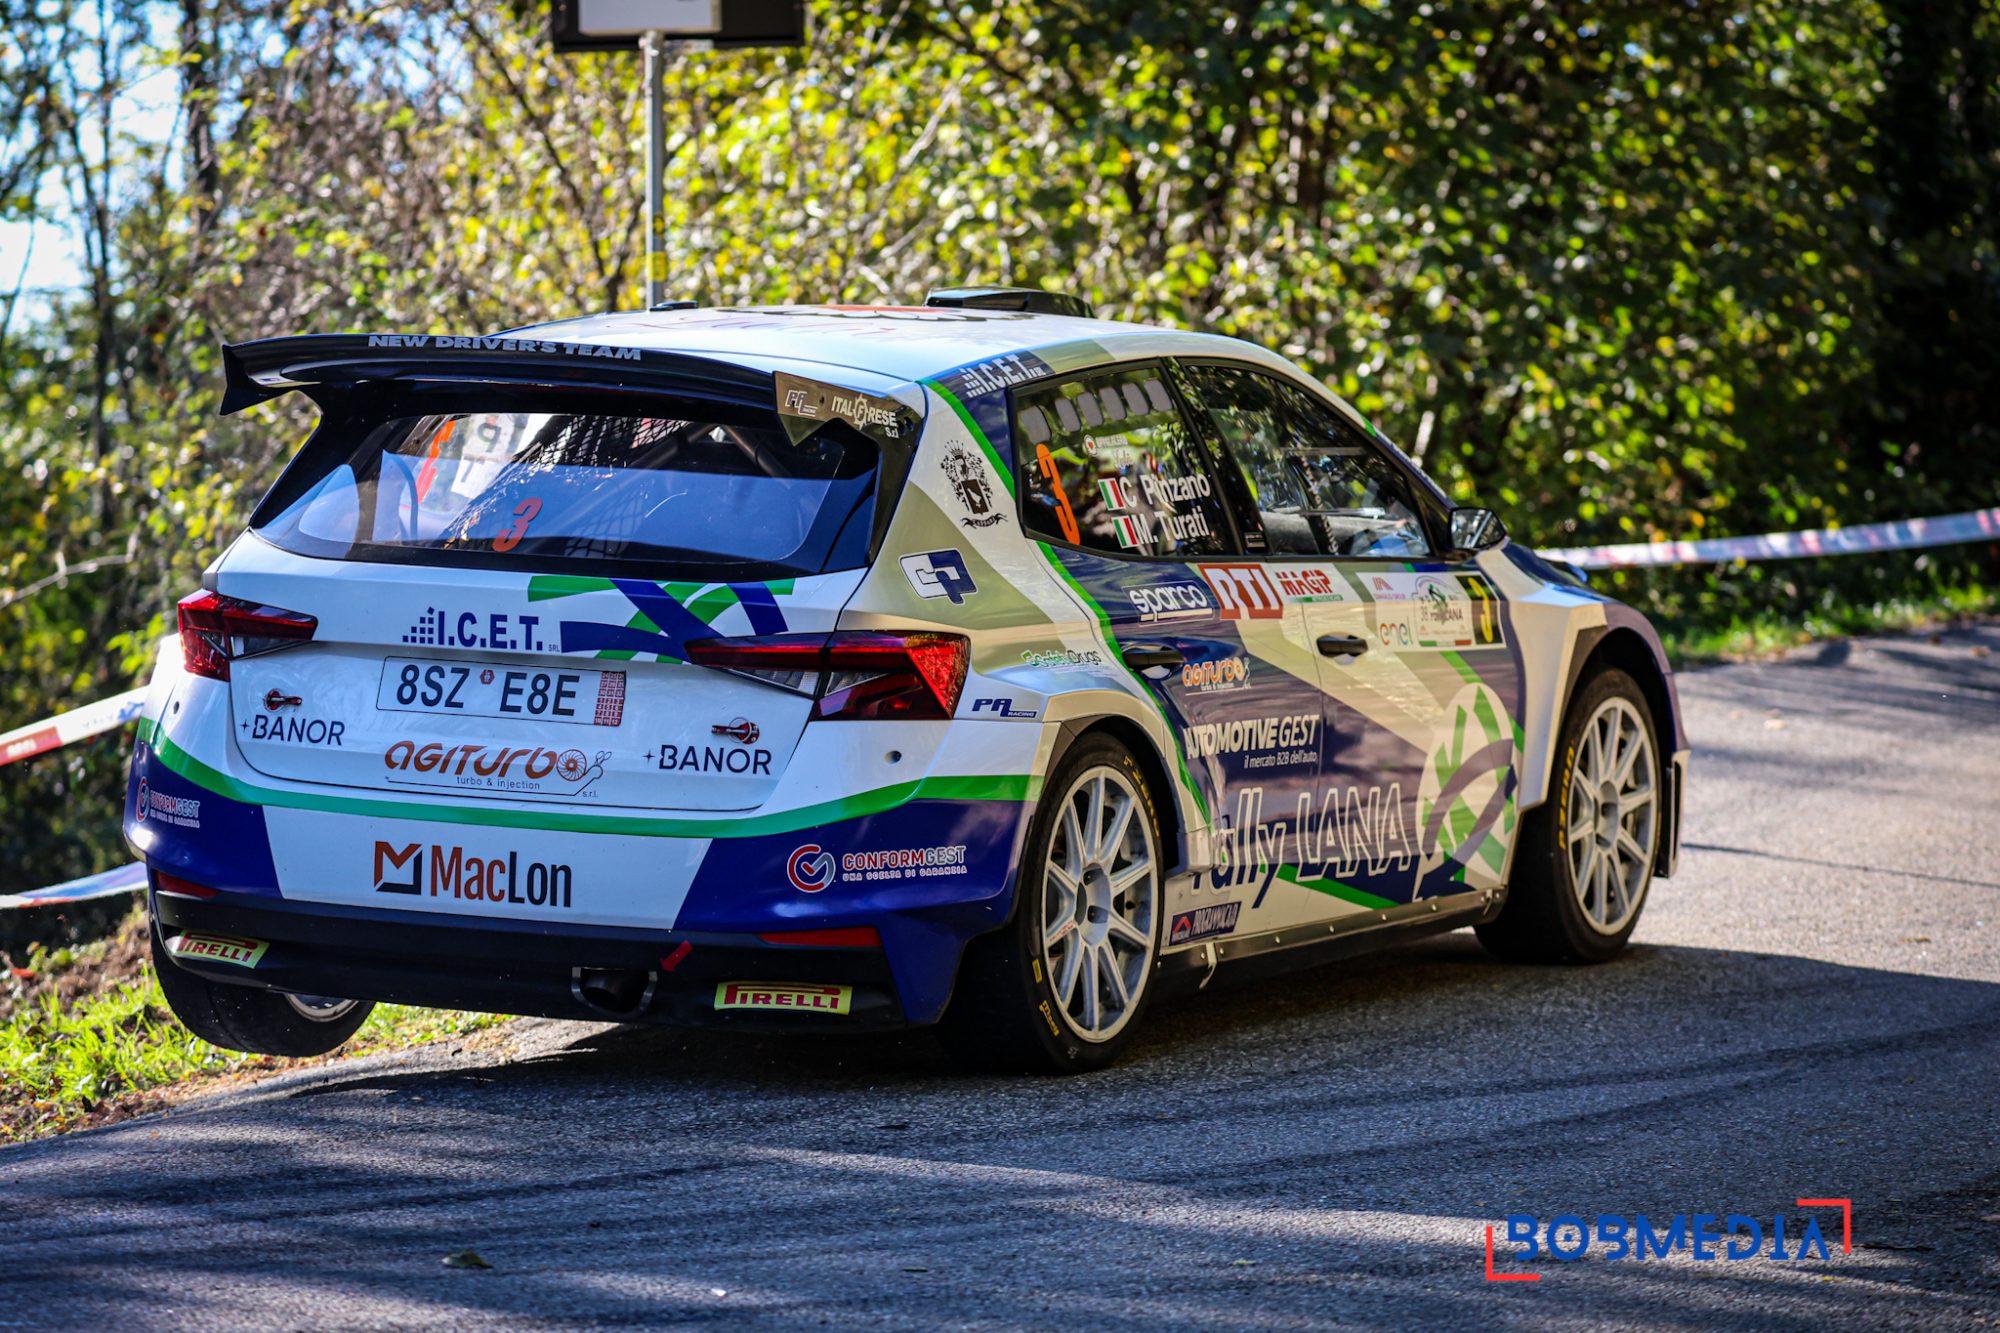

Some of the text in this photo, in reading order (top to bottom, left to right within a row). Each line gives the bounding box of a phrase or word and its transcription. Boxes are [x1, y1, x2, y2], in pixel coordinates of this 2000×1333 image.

[367, 335, 642, 361] NEW DRIVER'S TEAM
[1036, 442, 1081, 546] 3
[1140, 473, 1211, 505] Pinzano
[492, 497, 544, 553] 3
[1131, 506, 1210, 545] M. Turati
[1129, 584, 1208, 622] sparco
[1467, 576, 1494, 643] 3
[438, 610, 560, 653] I.C.E.T. SRL
[1379, 616, 1413, 646] enel
[396, 664, 581, 717] 8SZ E8E
[972, 698, 1013, 718] PA
[252, 713, 346, 746] BANOR
[659, 744, 772, 776] BANOR
[1244, 754, 1249, 769] il
[1249, 754, 1276, 769] mercato
[1276, 752, 1290, 766] B2B
[456, 775, 540, 791] turbo & injection
[1295, 782, 1412, 882] LANA
[842, 845, 967, 872] CONFORMGEST
[842, 865, 968, 882] UNA SCELTA DI GARANZIA
[430, 844, 572, 908] MacLon
[176, 931, 258, 964] PIRELLI
[724, 983, 842, 1010] PIRELLI
